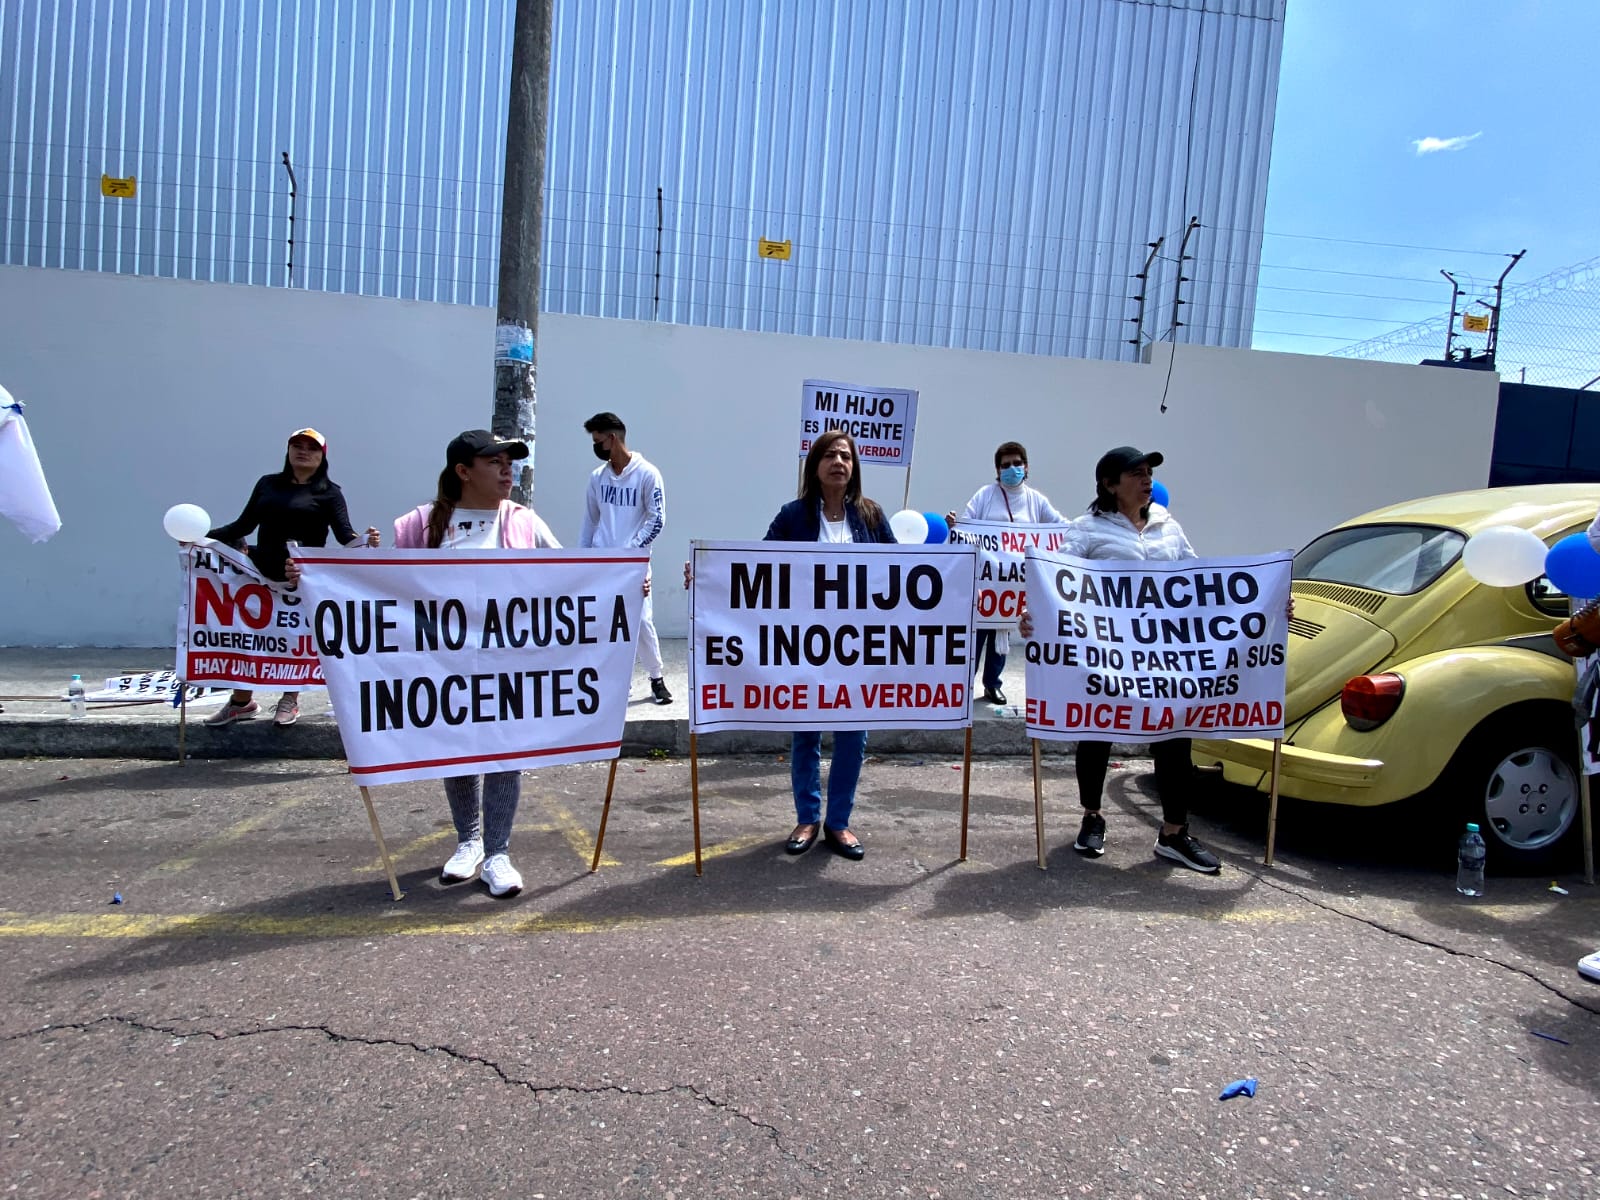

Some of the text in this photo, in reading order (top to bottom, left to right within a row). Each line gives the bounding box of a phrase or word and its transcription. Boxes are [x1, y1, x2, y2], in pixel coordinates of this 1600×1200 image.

[815, 391, 894, 418] MI HIJO
[804, 417, 903, 441] ES INOCENTE
[858, 445, 901, 458] VERDAD
[1001, 532, 1026, 553] PAZ
[1030, 532, 1041, 549] Y
[730, 563, 943, 611] MI HIJO
[1055, 569, 1259, 609] CAMACHO
[195, 577, 274, 630] NO
[276, 611, 300, 628] ES
[314, 595, 631, 659] QUE NO ACUSE A
[1057, 610, 1266, 644] ES EL ÚNICO
[193, 630, 288, 653] QUEREMOS
[706, 624, 967, 667] ES INOCENTE
[231, 660, 257, 679] UNA
[260, 663, 310, 680] FAMILIA
[1025, 641, 1285, 672] QUE DIO PARTE A SUS
[360, 667, 600, 733] INOCENTES
[702, 683, 964, 710] EL DICE LA VERDAD
[1085, 673, 1239, 699] SUPERIORES
[1025, 698, 1282, 731] EL DICE LA VERDAD
